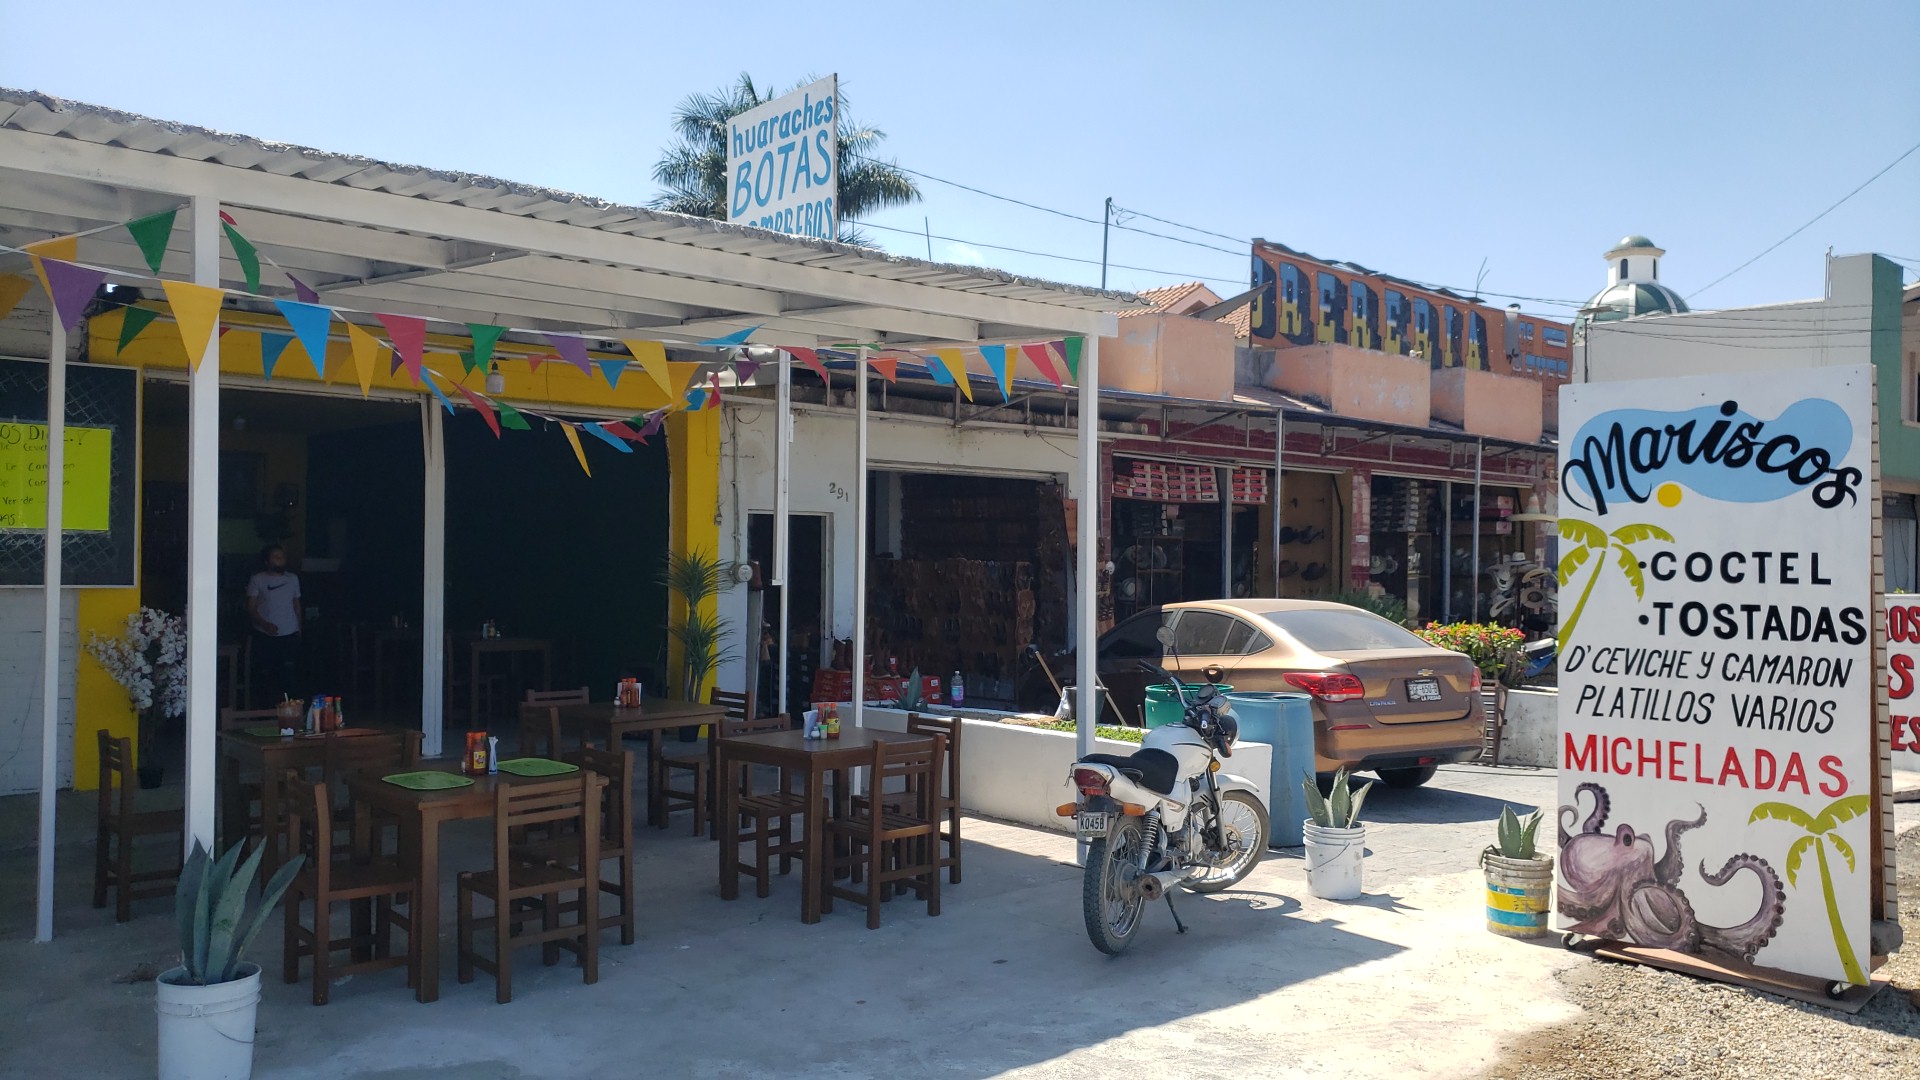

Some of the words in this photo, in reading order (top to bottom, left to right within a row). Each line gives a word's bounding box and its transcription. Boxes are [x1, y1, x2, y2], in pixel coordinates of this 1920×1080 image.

[733, 93, 833, 158] huaraches
[732, 129, 832, 218] BOTAS
[1561, 400, 1862, 516] Mariscos
[829, 482, 848, 502] 291
[1651, 551, 1831, 585] COCTEL
[1653, 601, 1867, 645] TOSTADAS
[1722, 652, 1853, 689] CAMARON
[1575, 685, 1715, 725] PLATILLOS
[1731, 693, 1837, 734] VARIOS
[1565, 732, 1848, 798] MICHELADAS
